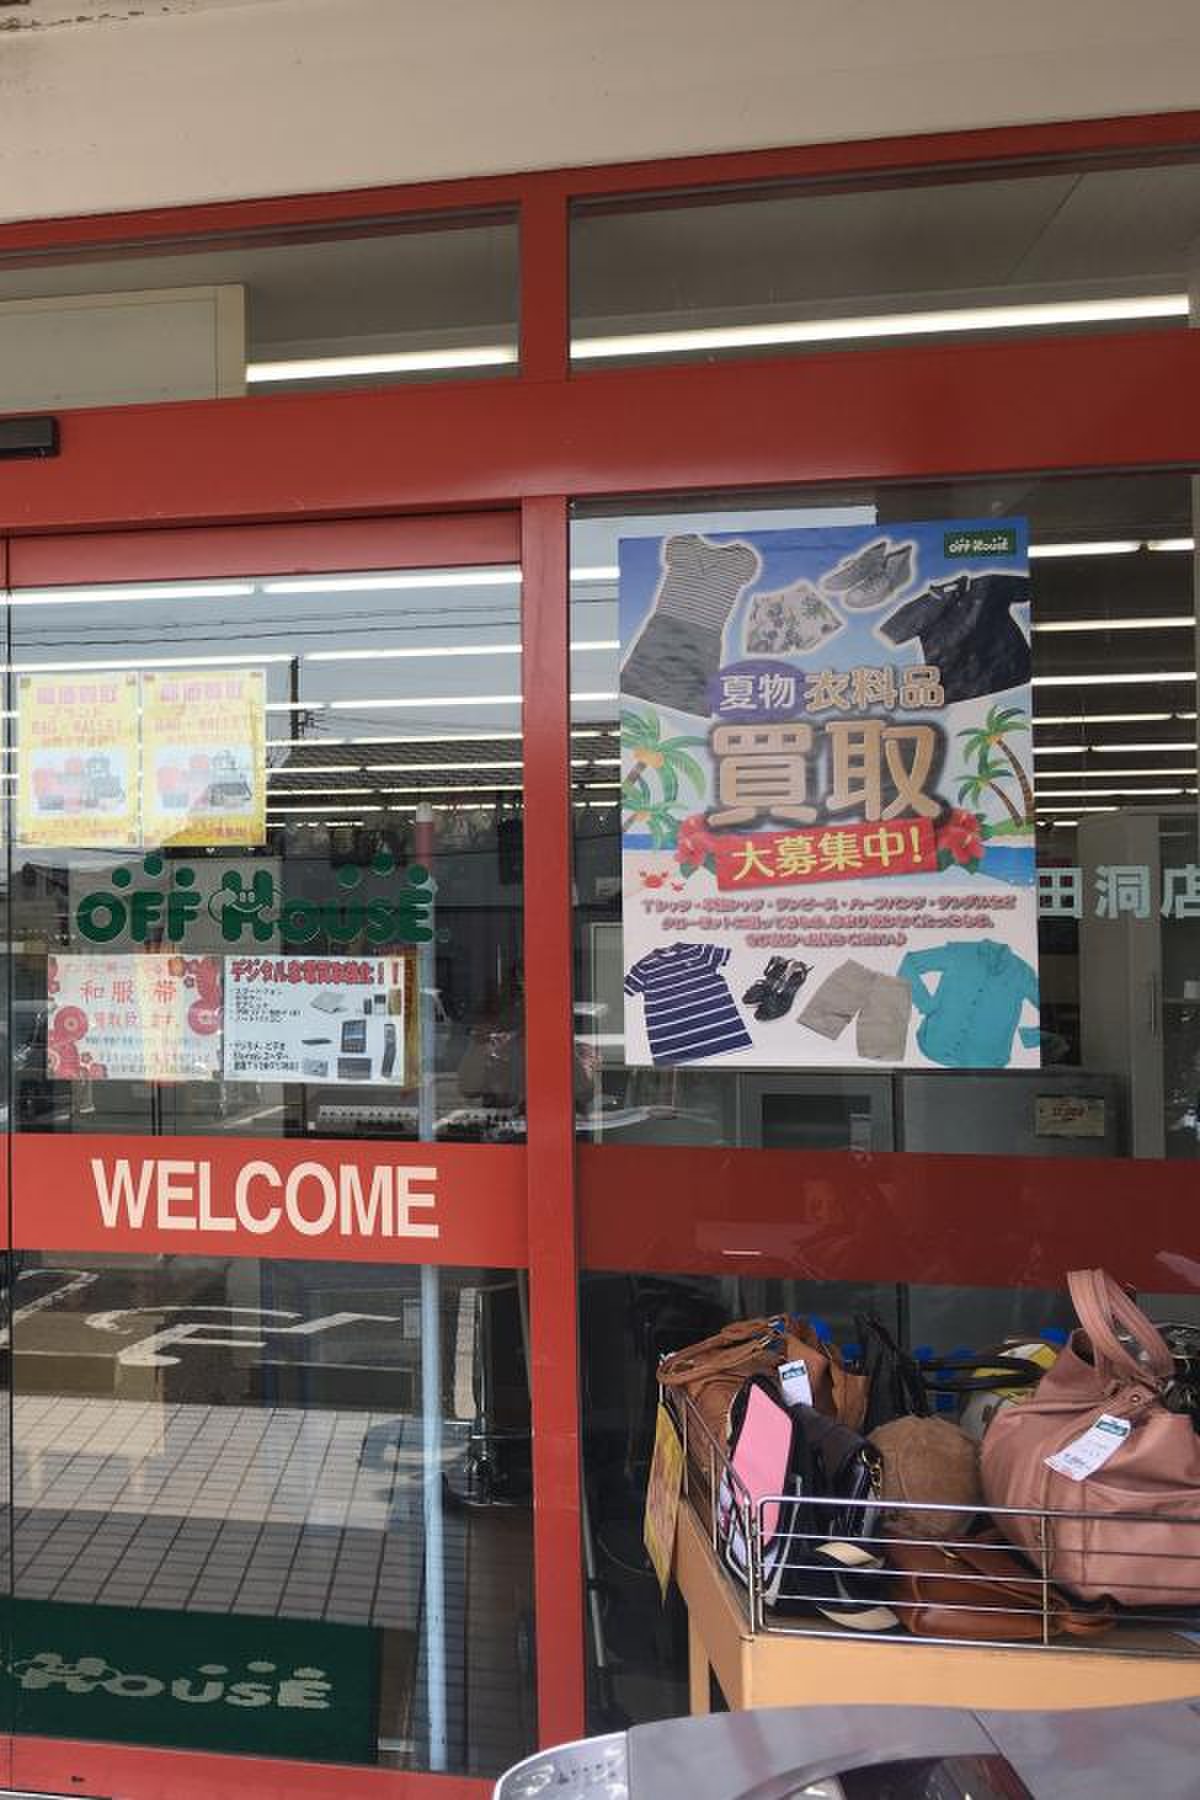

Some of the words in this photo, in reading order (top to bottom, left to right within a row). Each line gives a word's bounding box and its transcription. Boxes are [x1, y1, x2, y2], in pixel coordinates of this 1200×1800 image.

[719, 673, 796, 709] 夏物
[804, 666, 945, 711] 衣料品
[709, 719, 942, 827] 買取
[731, 826, 924, 881] 大募集中!
[77, 860, 202, 943] OFF
[218, 856, 434, 943] HOUSE
[1039, 865, 1200, 919] 田洞店
[91, 1158, 440, 1239] WELCOME
